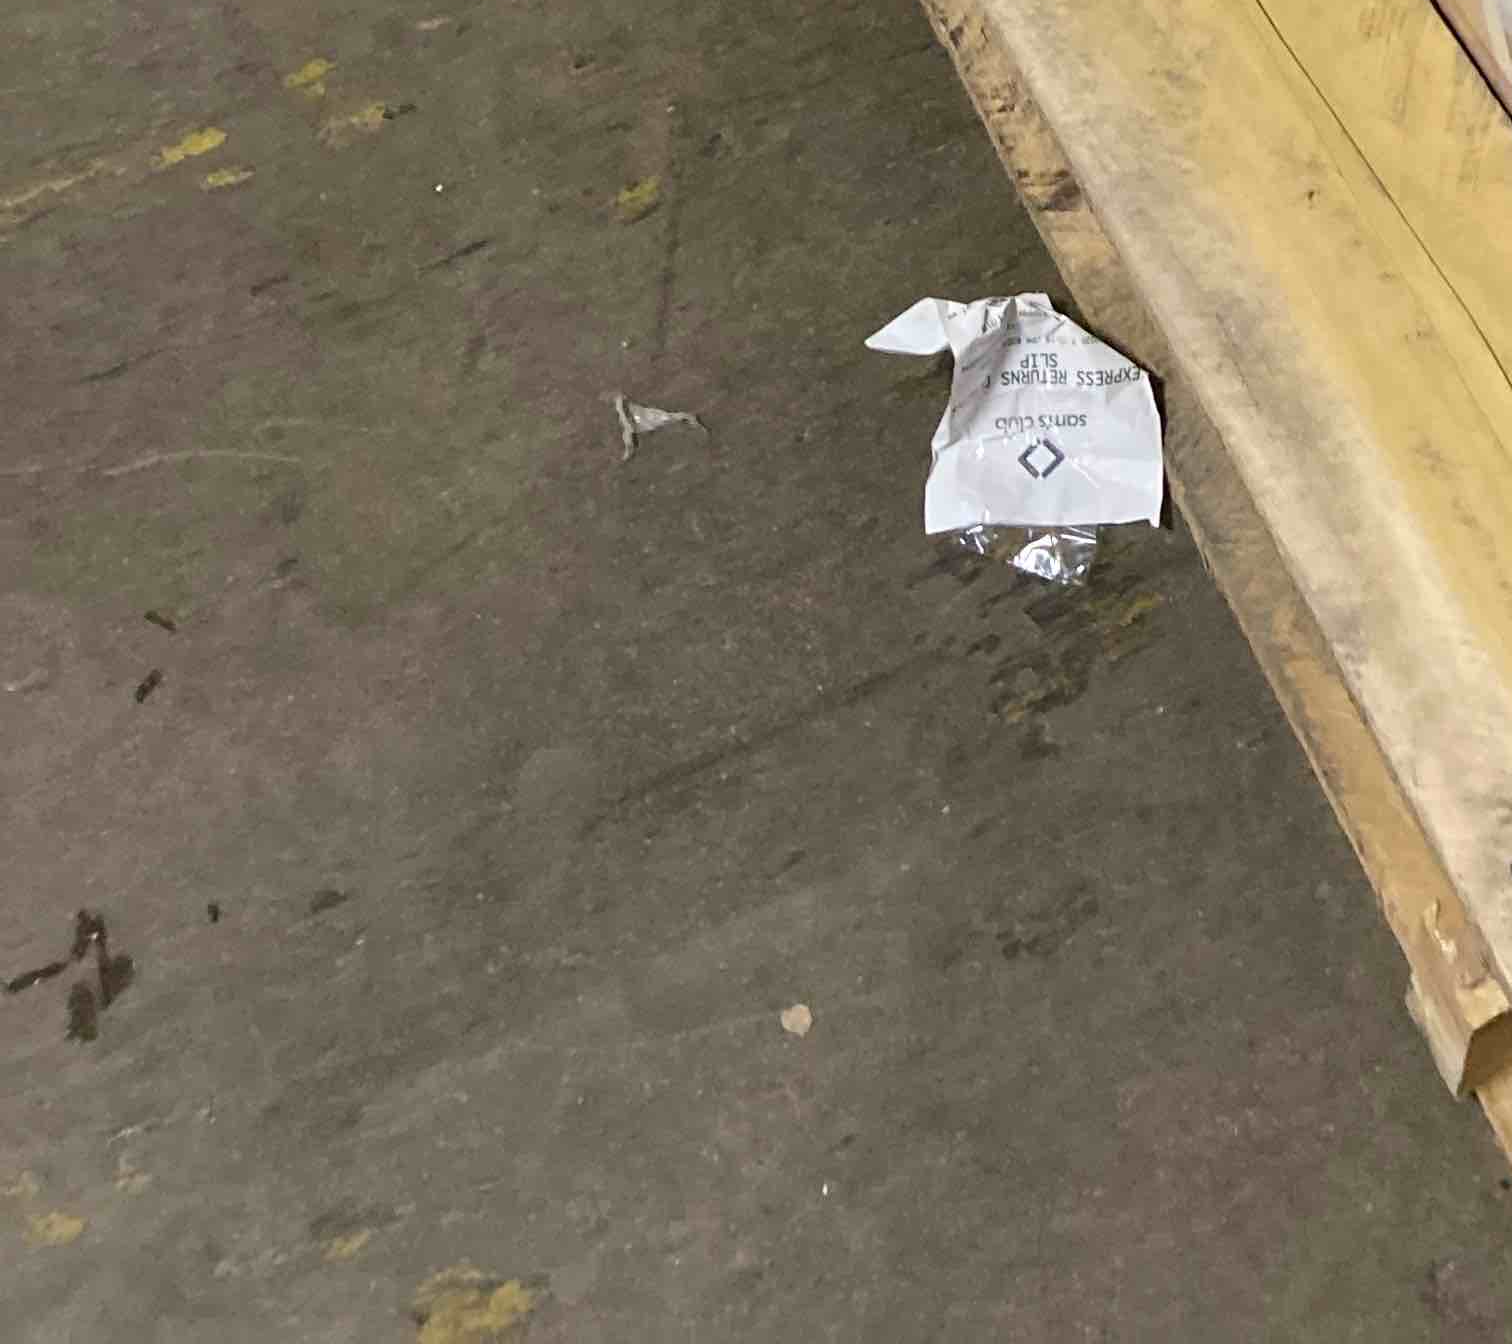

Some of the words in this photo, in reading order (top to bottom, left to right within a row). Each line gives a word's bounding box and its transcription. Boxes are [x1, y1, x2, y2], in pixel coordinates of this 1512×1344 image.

[1019, 352, 1059, 369] SLIP
[1000, 369, 1069, 387] RETURNS
[1074, 365, 1142, 387] EXPRESS
